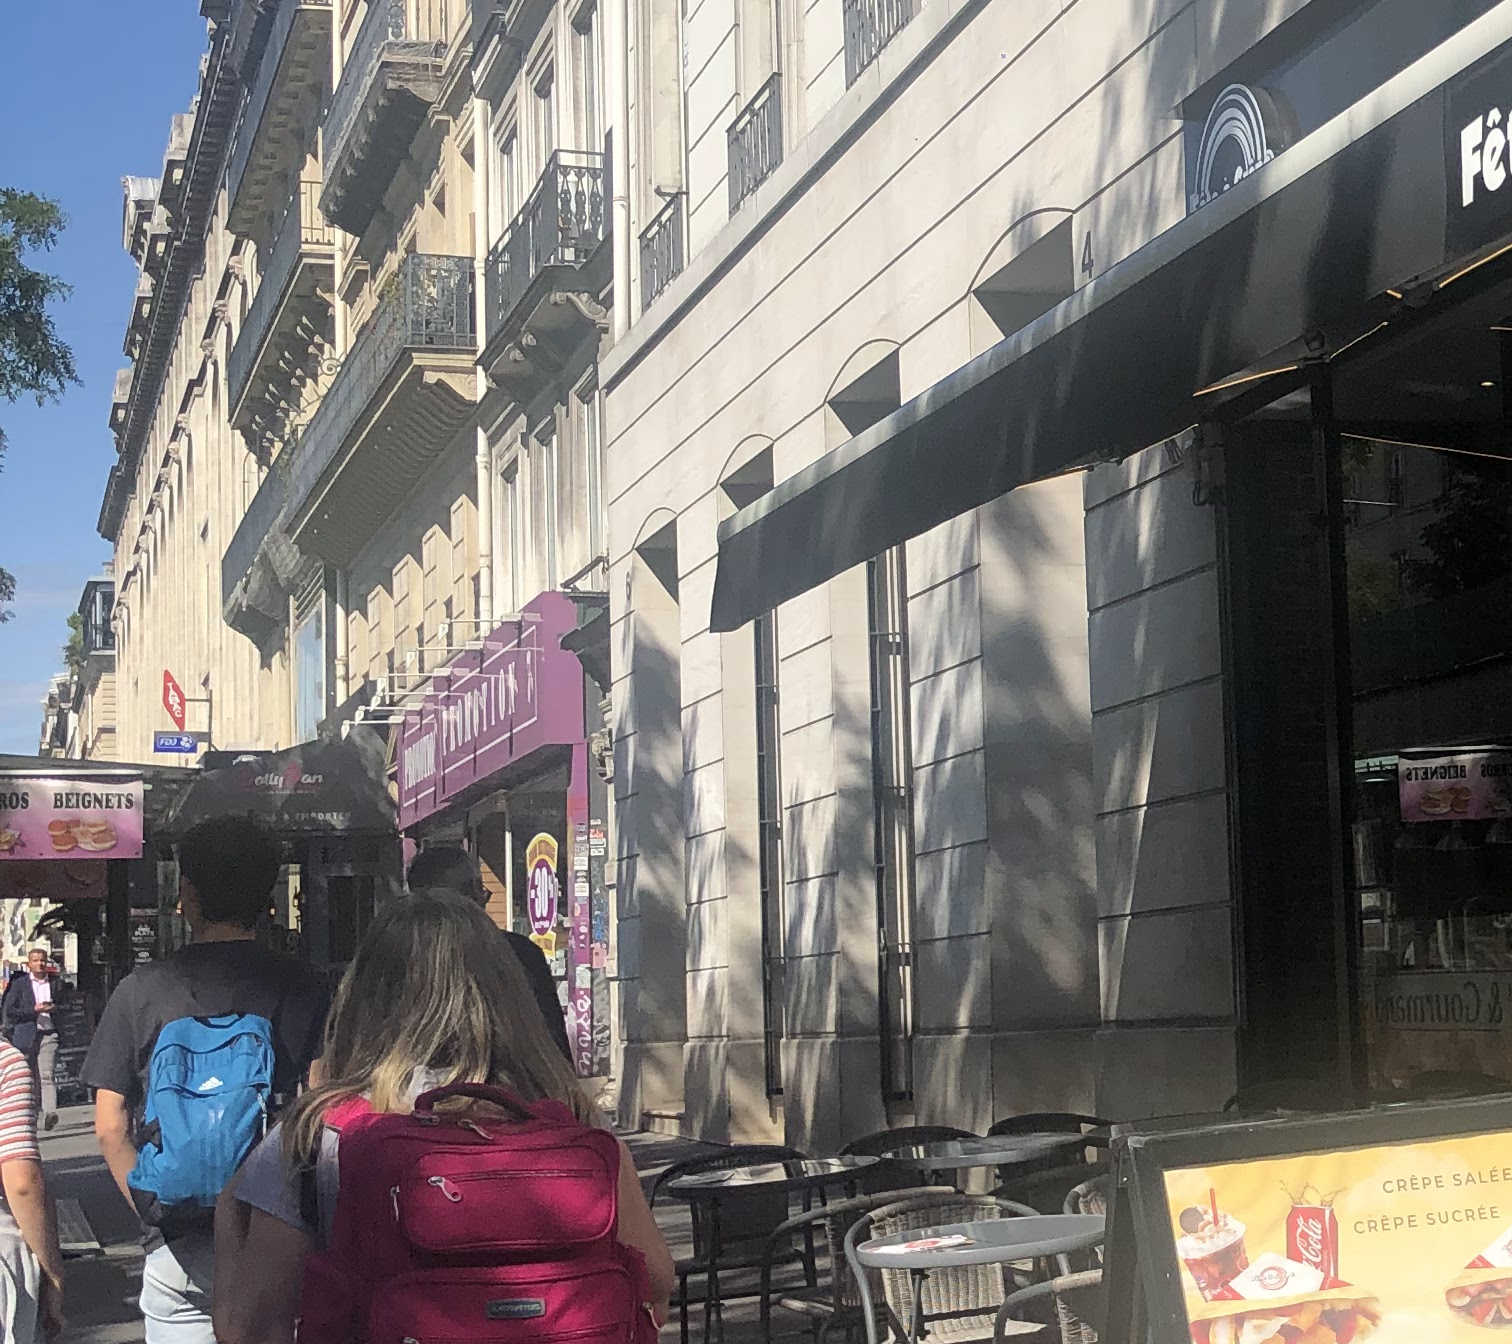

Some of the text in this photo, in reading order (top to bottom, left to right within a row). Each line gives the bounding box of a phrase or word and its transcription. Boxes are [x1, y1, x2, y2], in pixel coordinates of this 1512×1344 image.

[1082, 230, 1093, 279] 4
[53, 792, 134, 809] BEIGNETS
[1382, 1165, 1512, 1195] CRÊPE SALÉE
[1353, 1203, 1500, 1235] CRÊPE SUCRÉE
